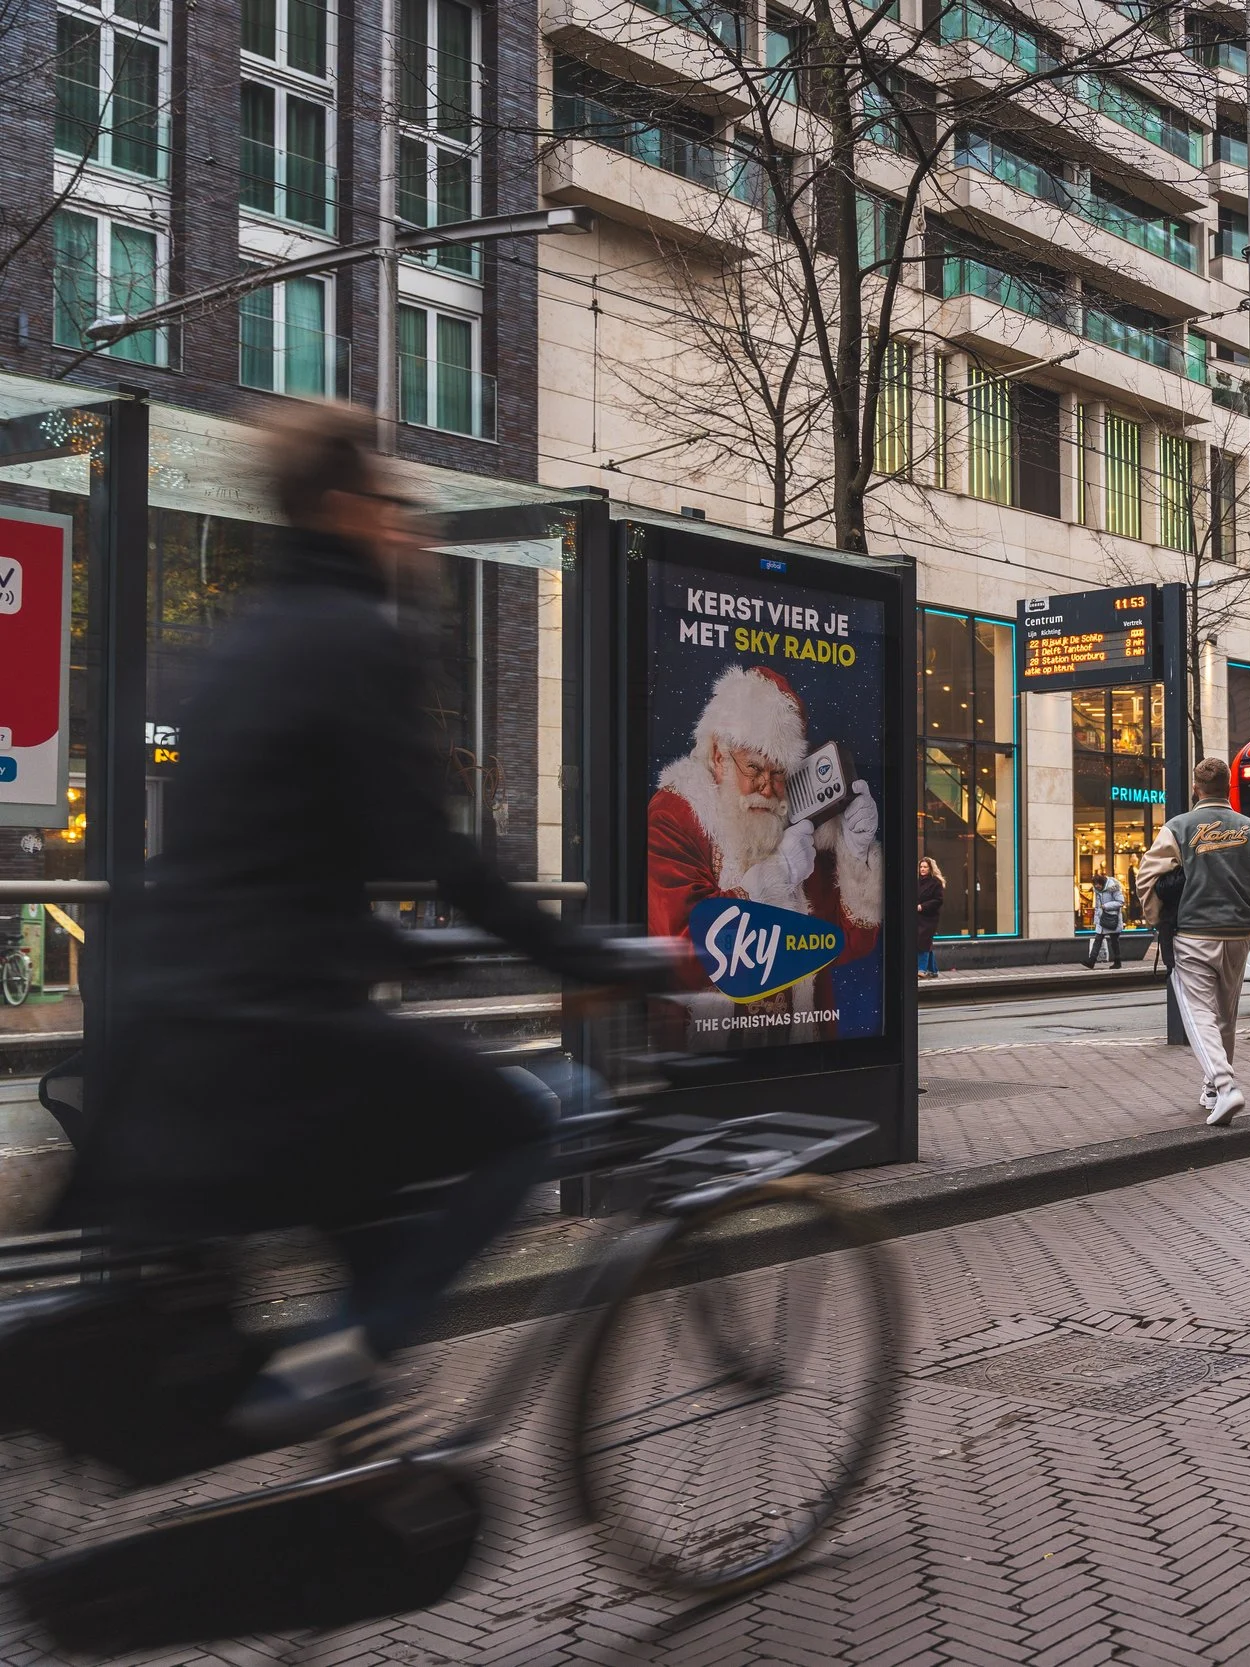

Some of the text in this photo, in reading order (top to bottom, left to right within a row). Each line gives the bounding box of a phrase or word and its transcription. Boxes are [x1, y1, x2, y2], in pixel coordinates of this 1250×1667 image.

[687, 588, 849, 637] KERST VIER JE
[1024, 615, 1063, 627] Centrum
[1123, 619, 1143, 627] Vertrek
[679, 618, 856, 667] MET SKY RADIO
[1027, 628, 1061, 639] Lijn Richting
[1029, 633, 1103, 648] 22 Rijswijk De Schilp
[1041, 646, 1062, 656] Delft
[1063, 642, 1093, 653] Tanthof
[1133, 637, 1145, 646] min
[1041, 655, 1069, 665] Station
[1070, 651, 1105, 662] Voorburg
[1133, 647, 1145, 656] min
[1042, 666, 1052, 675] op
[1111, 786, 1167, 804] PRIMARK
[1188, 820, 1250, 848] Kani
[705, 905, 781, 986] Sky
[785, 933, 837, 951] RADIO
[694, 1009, 840, 1032] THE CHRISTMAS STATION
